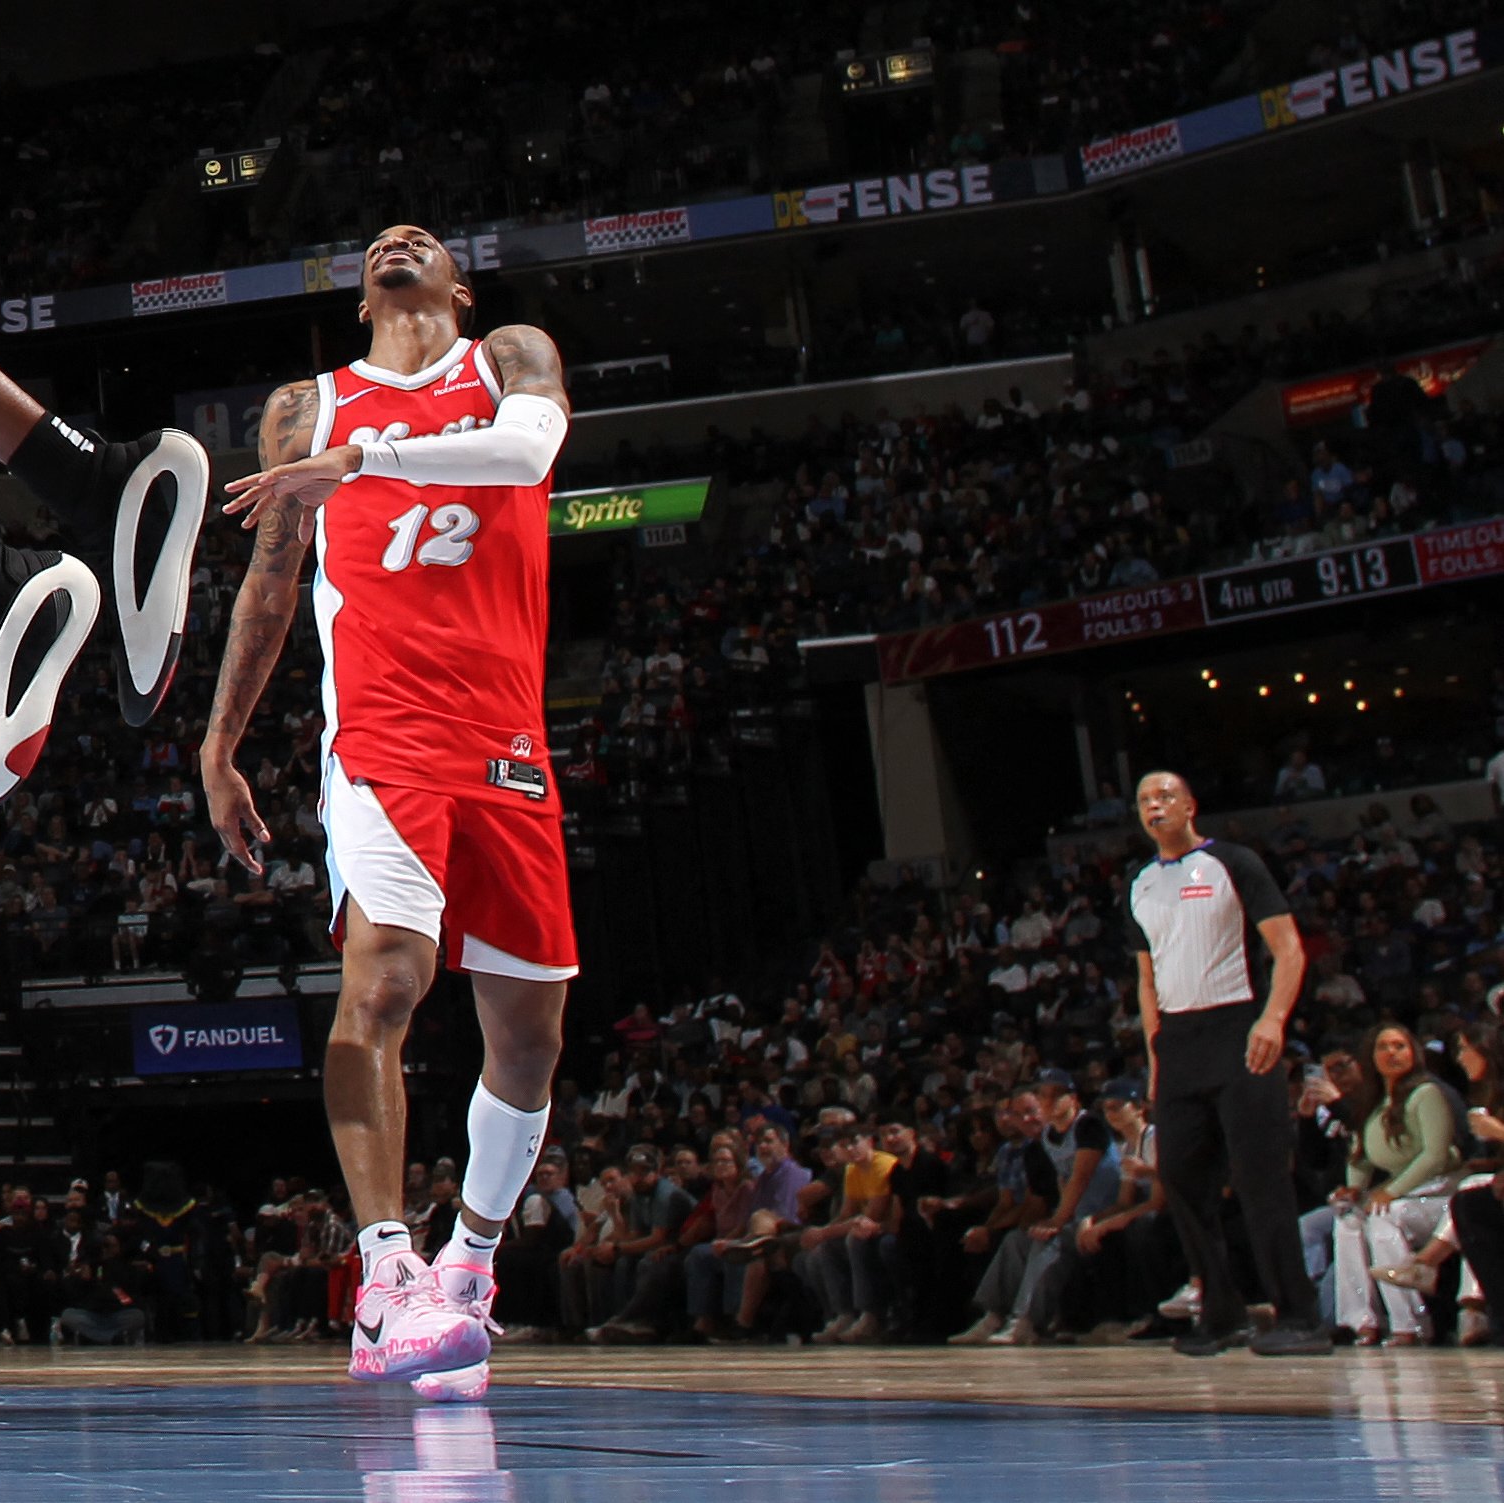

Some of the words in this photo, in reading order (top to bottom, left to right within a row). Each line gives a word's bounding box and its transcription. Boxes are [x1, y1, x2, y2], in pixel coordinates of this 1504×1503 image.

[586, 209, 687, 234] SealMaster
[132, 274, 222, 296] SealMaster
[433, 378, 481, 397] Robinhood
[563, 495, 643, 530] Sprite
[381, 502, 481, 573] 12
[646, 526, 685, 544] 116A
[1424, 523, 1504, 554] TIMEOU
[1316, 546, 1391, 596] 9:13
[1219, 579, 1256, 610] 4TH
[982, 611, 1048, 659] 112
[184, 1026, 284, 1047] FANDUEL
